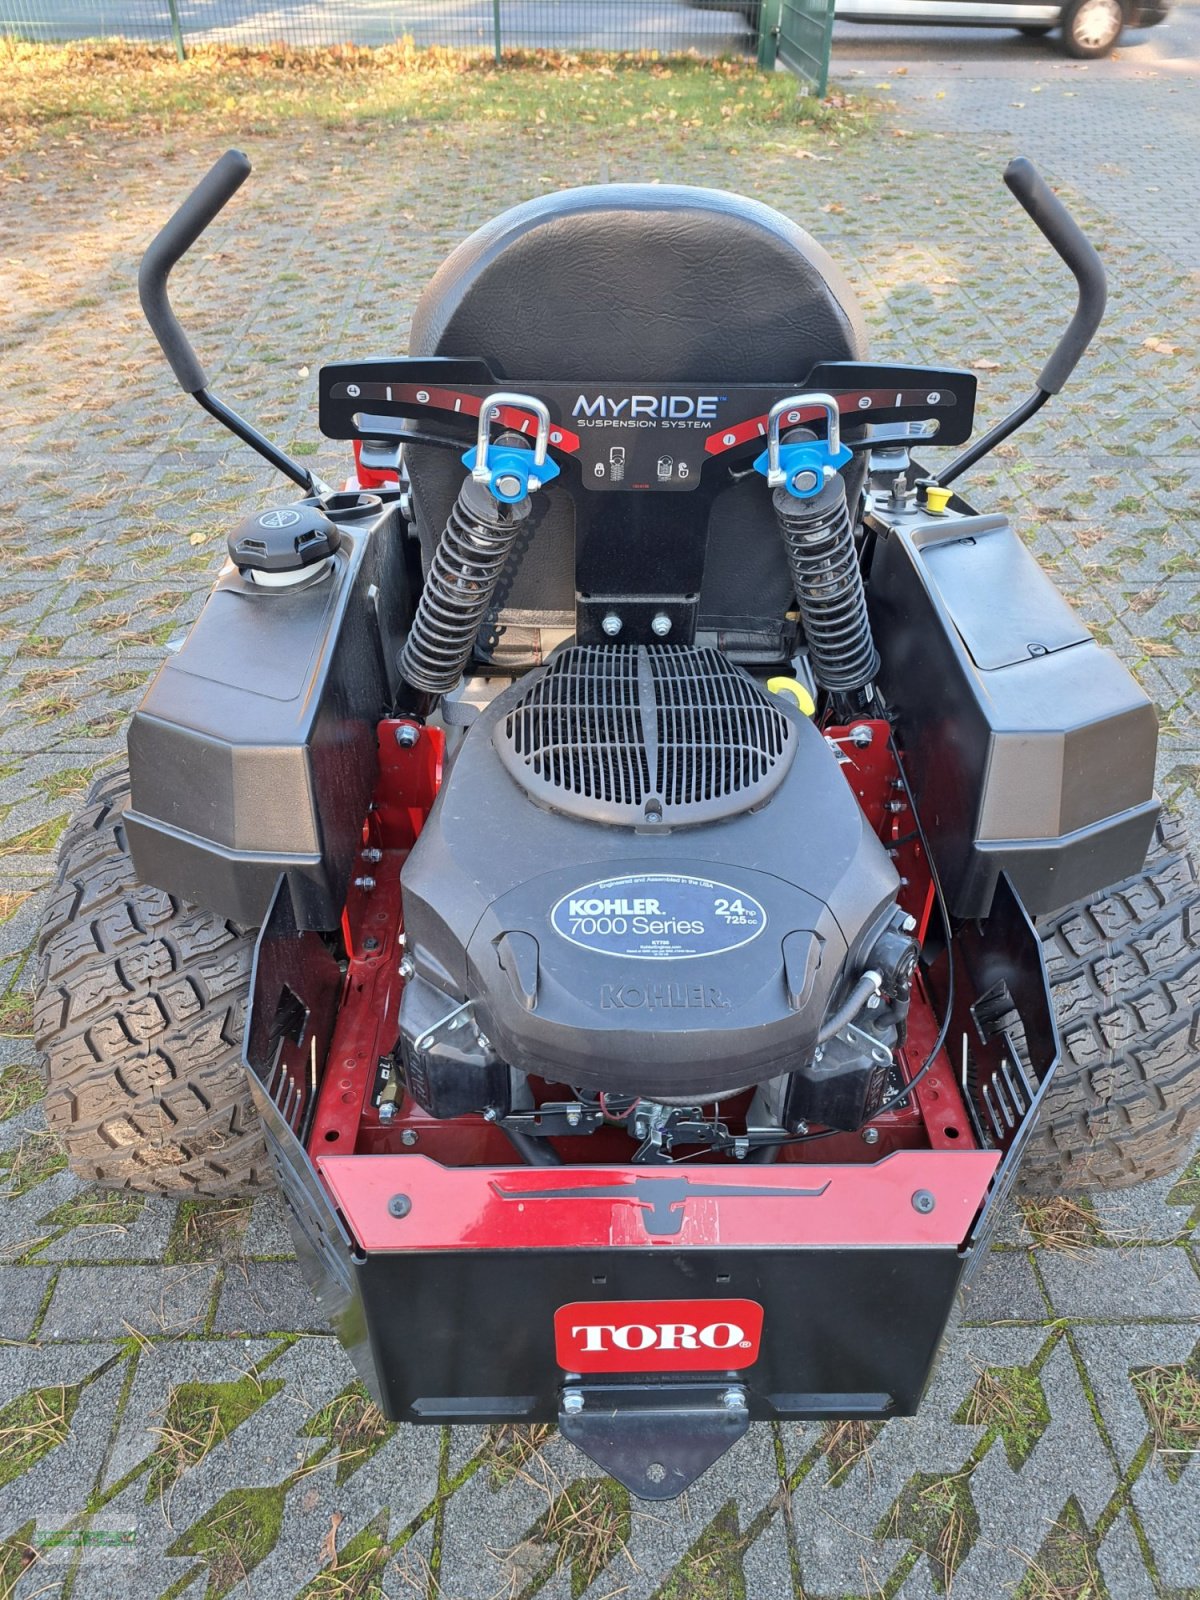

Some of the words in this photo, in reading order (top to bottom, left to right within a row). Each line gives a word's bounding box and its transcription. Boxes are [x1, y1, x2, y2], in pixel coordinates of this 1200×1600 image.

[577, 419, 657, 428] SUSPENSION
[662, 420, 712, 429] SYSTEM
[699, 879, 714, 889] USA
[714, 898, 745, 916] 24
[724, 915, 747, 925] 725
[568, 917, 627, 935] 7000
[632, 916, 705, 935] Series
